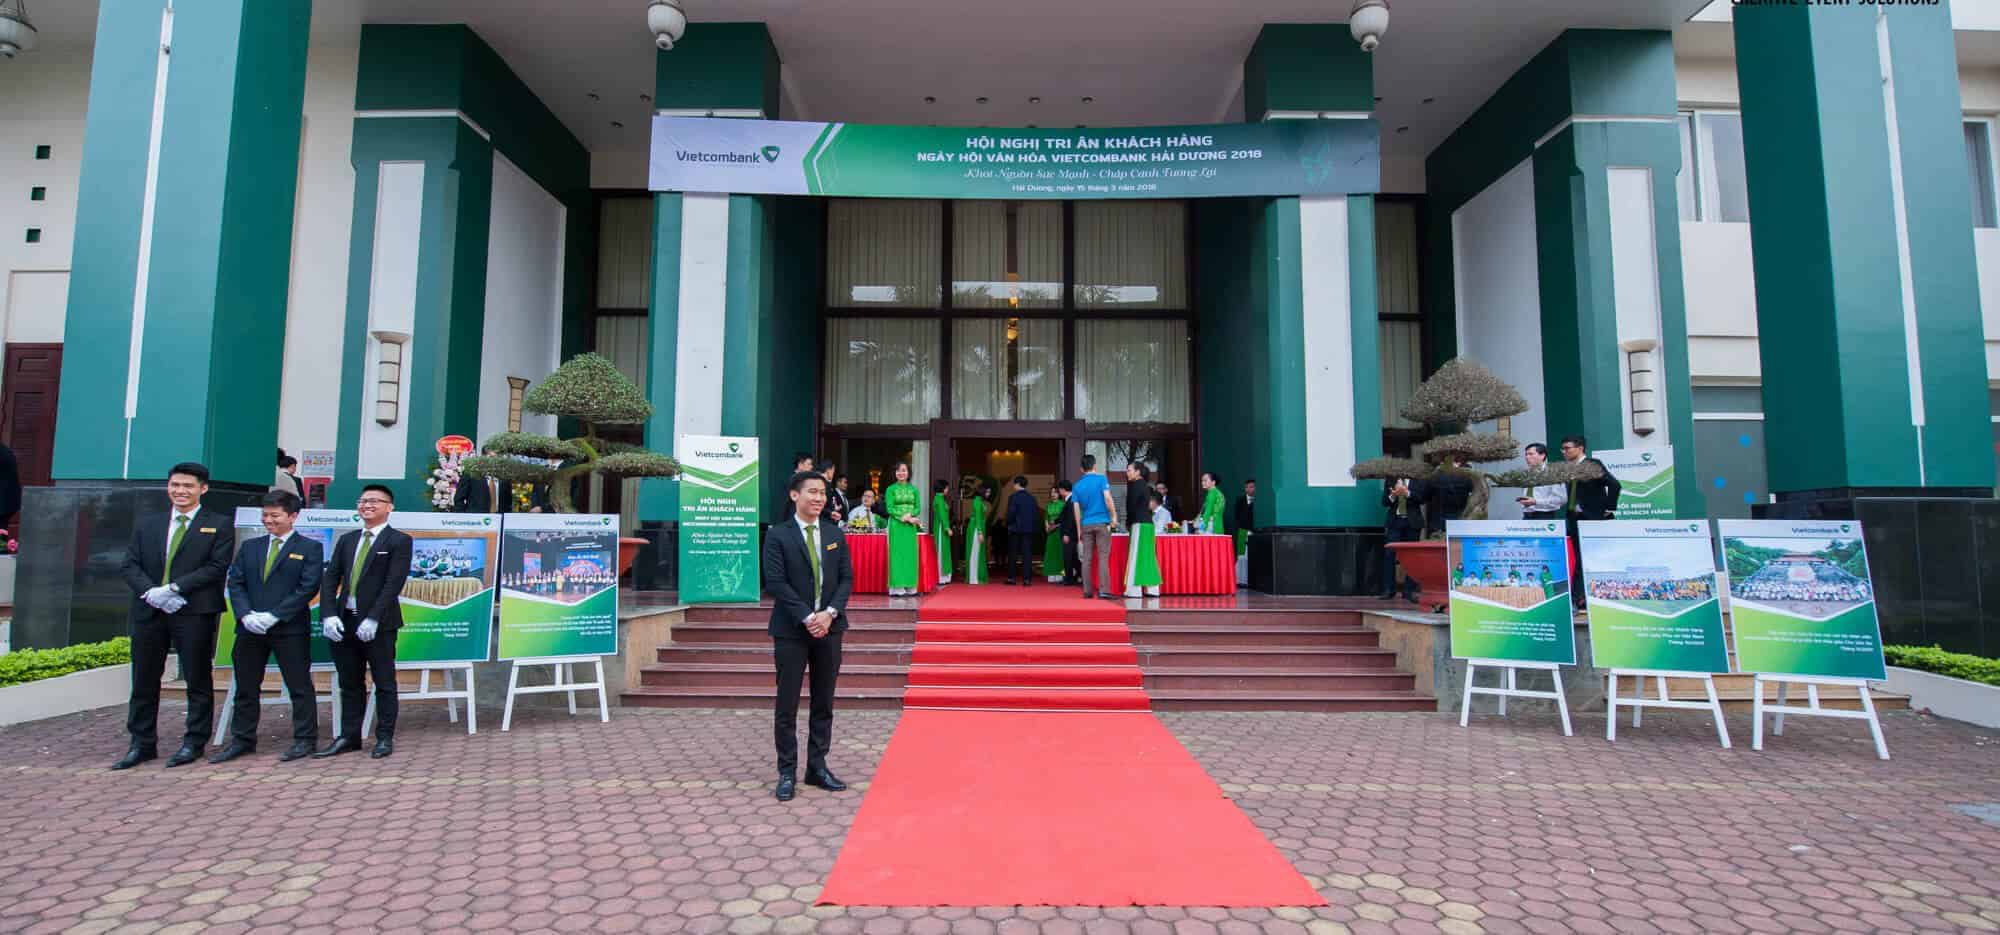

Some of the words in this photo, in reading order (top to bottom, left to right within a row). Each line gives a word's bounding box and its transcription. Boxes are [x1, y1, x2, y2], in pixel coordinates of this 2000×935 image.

[1000, 138, 1040, 151] NGHỊ
[1044, 138, 1072, 149] TRI
[1077, 136, 1100, 149] ÂN
[1104, 136, 1161, 149] KHÁCH
[676, 150, 760, 163] Vietcombank
[1051, 152, 1147, 163] VIETCOMBANK
[1231, 149, 1263, 160] 2018
[695, 450, 743, 458] Vietcombank
[307, 515, 351, 523] Vietcombank
